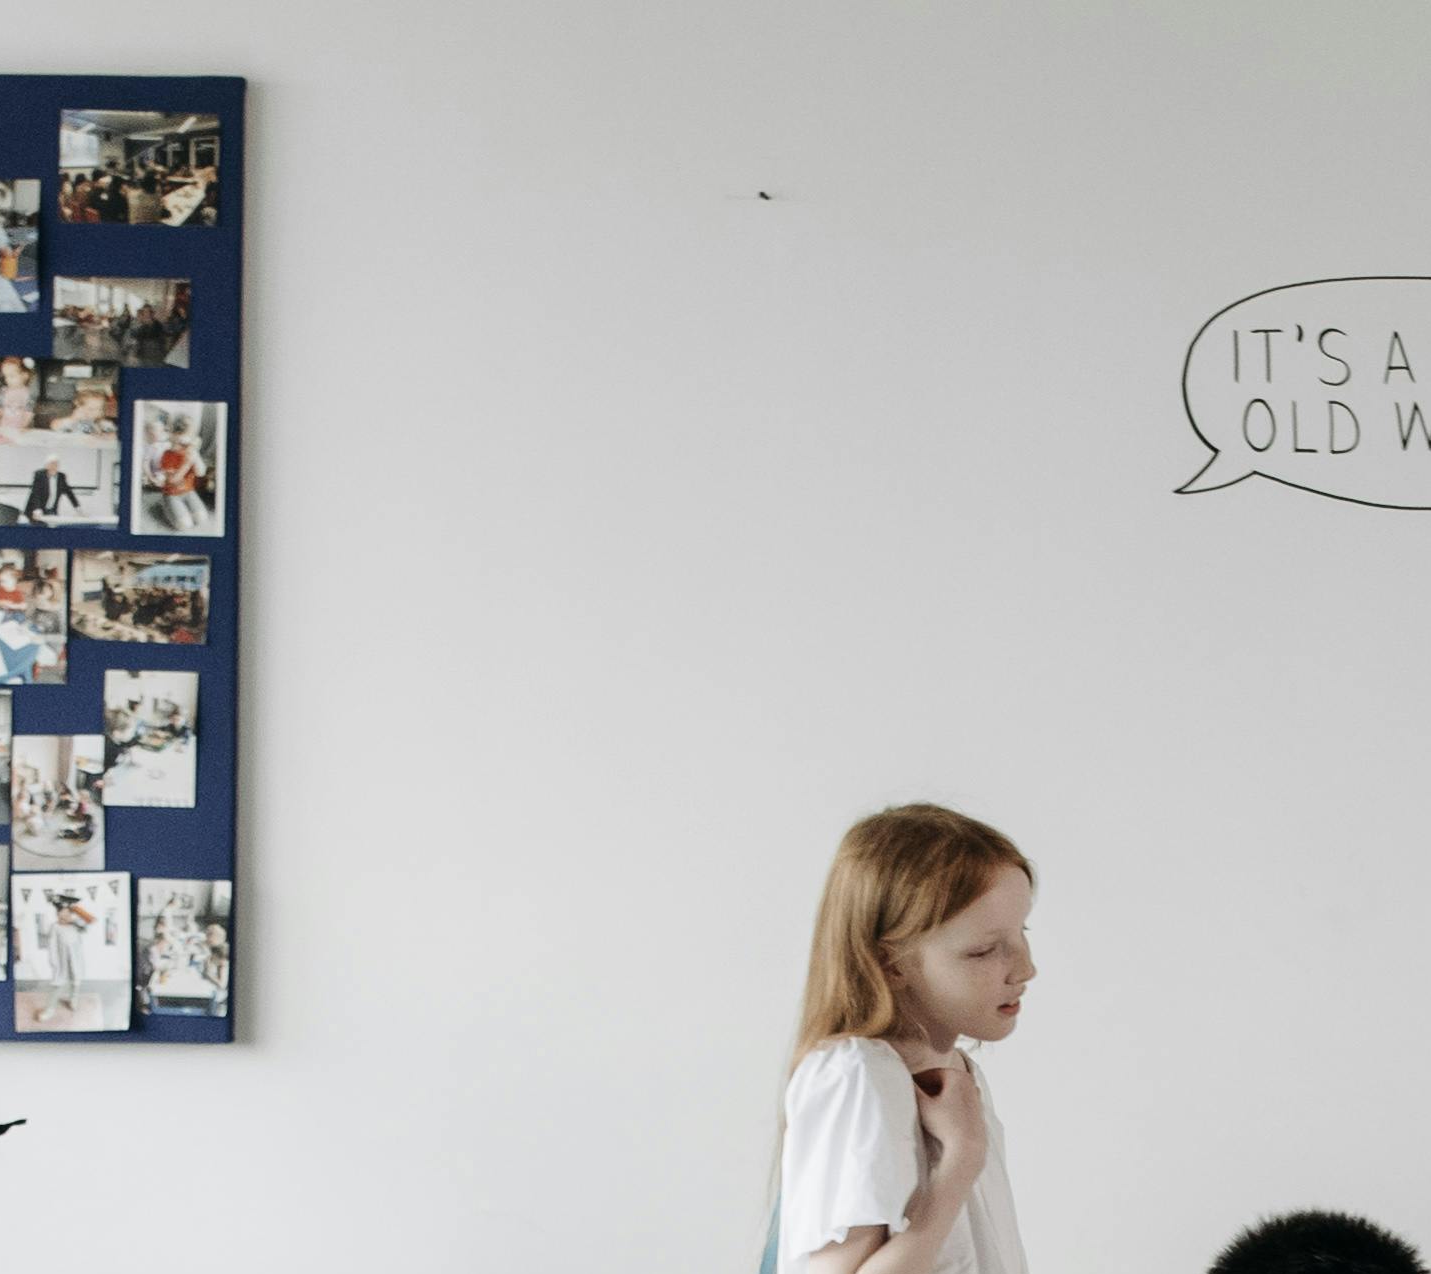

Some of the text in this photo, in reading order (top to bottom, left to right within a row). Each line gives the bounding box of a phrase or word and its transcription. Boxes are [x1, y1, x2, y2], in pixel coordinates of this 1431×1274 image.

[1232, 323, 1352, 387] IT'S
[1383, 330, 1416, 385] A
[1242, 397, 1361, 455] OLD
